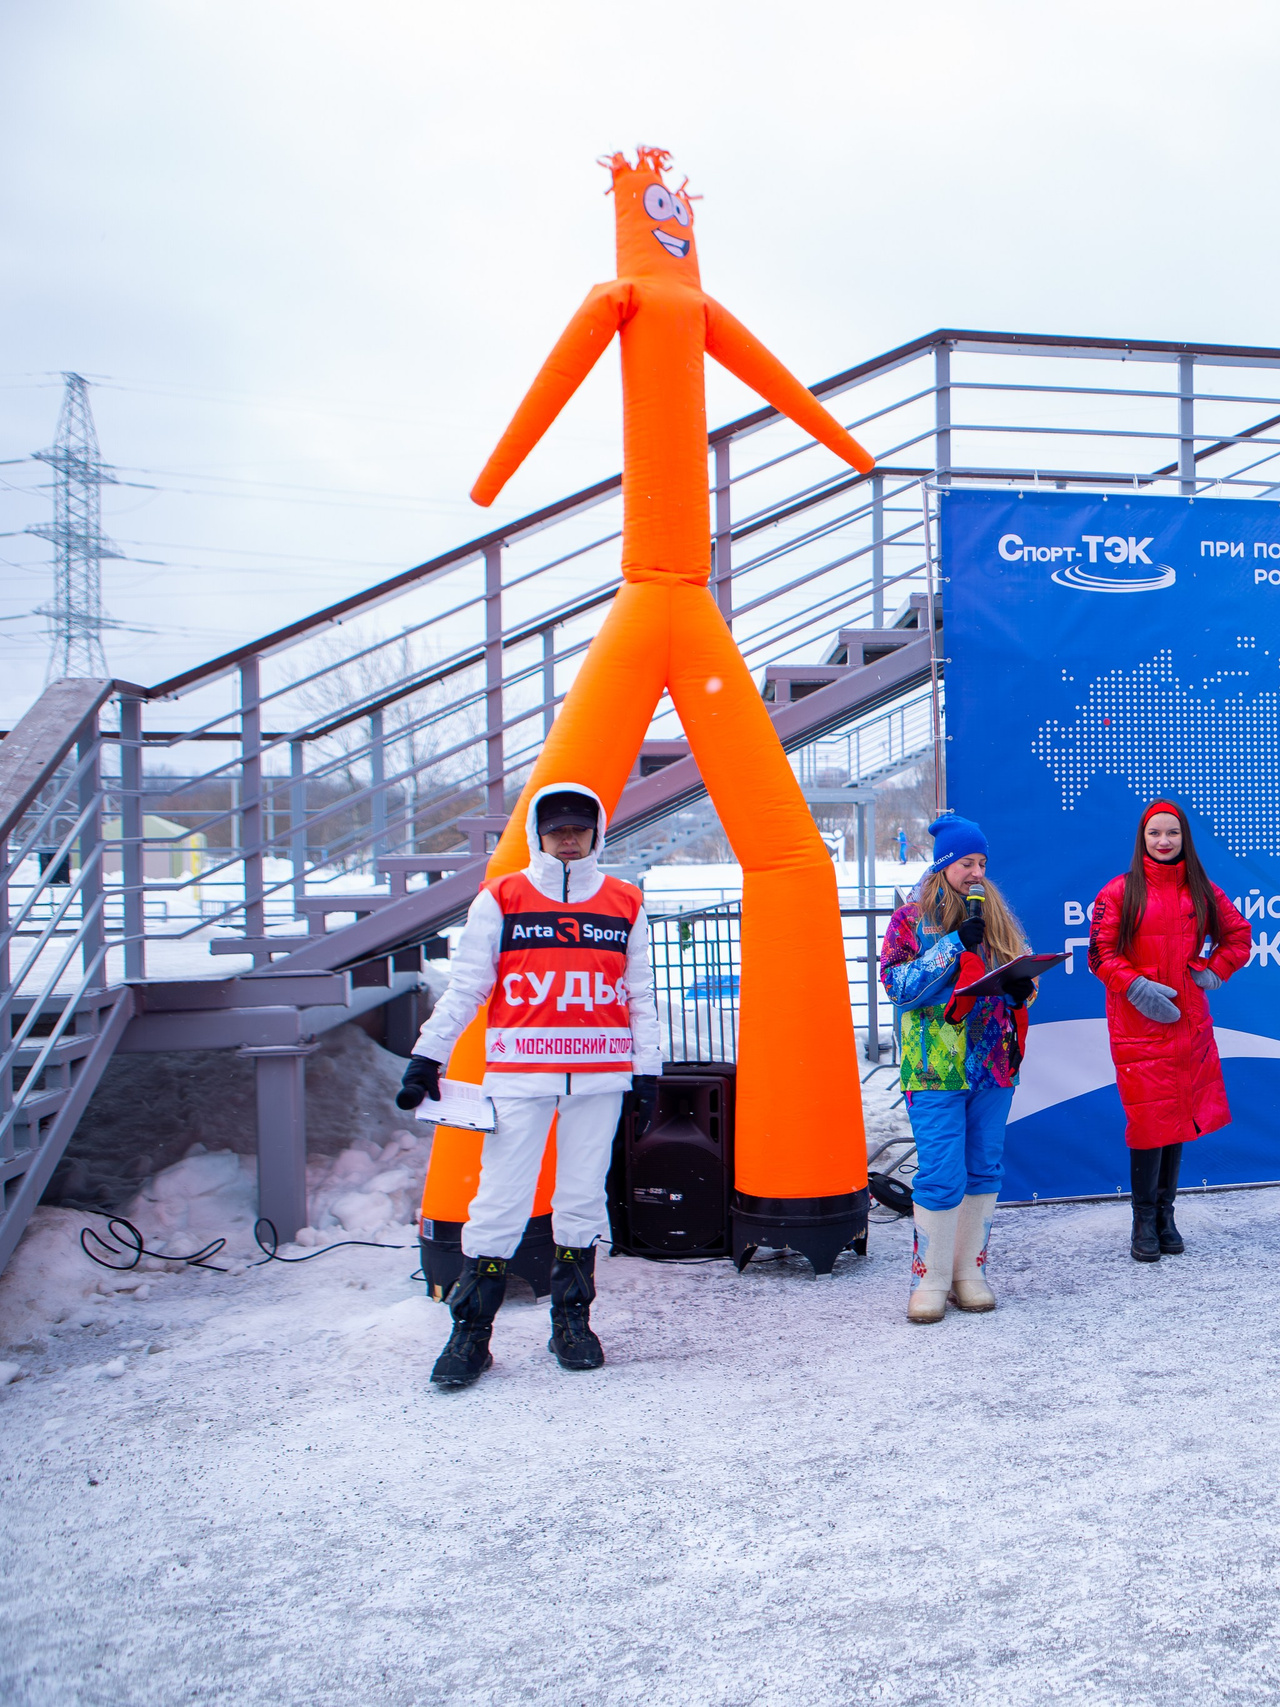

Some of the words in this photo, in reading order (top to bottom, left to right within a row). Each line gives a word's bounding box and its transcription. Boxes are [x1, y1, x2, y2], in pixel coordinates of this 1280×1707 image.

[1200, 540, 1245, 558] ПРИ
[512, 924, 554, 940] Arta
[583, 924, 628, 943] Sport
[515, 1034, 607, 1055] МОСКОВСКИЙ
